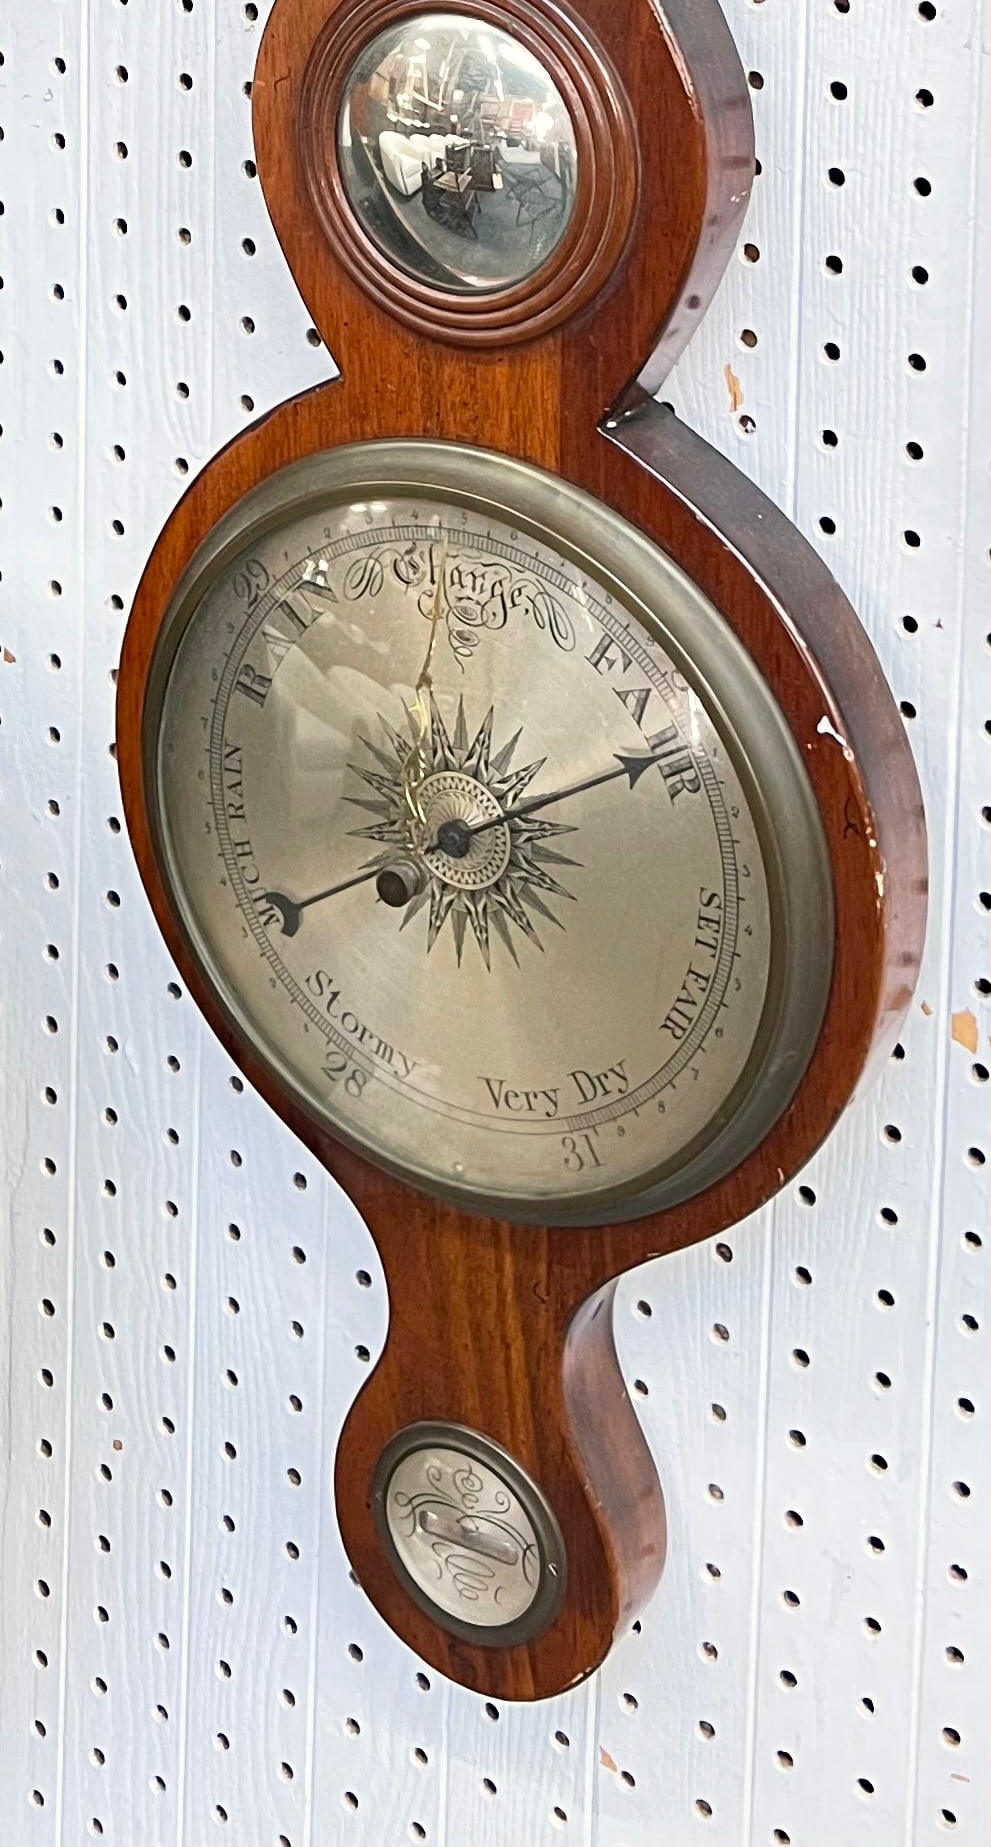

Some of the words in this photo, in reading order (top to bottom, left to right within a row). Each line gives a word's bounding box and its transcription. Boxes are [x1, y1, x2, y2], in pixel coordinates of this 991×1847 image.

[233, 558, 270, 608] 29
[584, 626, 701, 807] FAIR
[223, 736, 248, 825] RAIN
[694, 886, 723, 960] SET
[304, 968, 419, 1079] Stormy
[657, 960, 711, 1041] FAIR
[320, 1050, 369, 1099] 28
[476, 1075, 562, 1119] Very
[566, 1057, 630, 1106] Dry
[560, 1132, 607, 1173] 31
